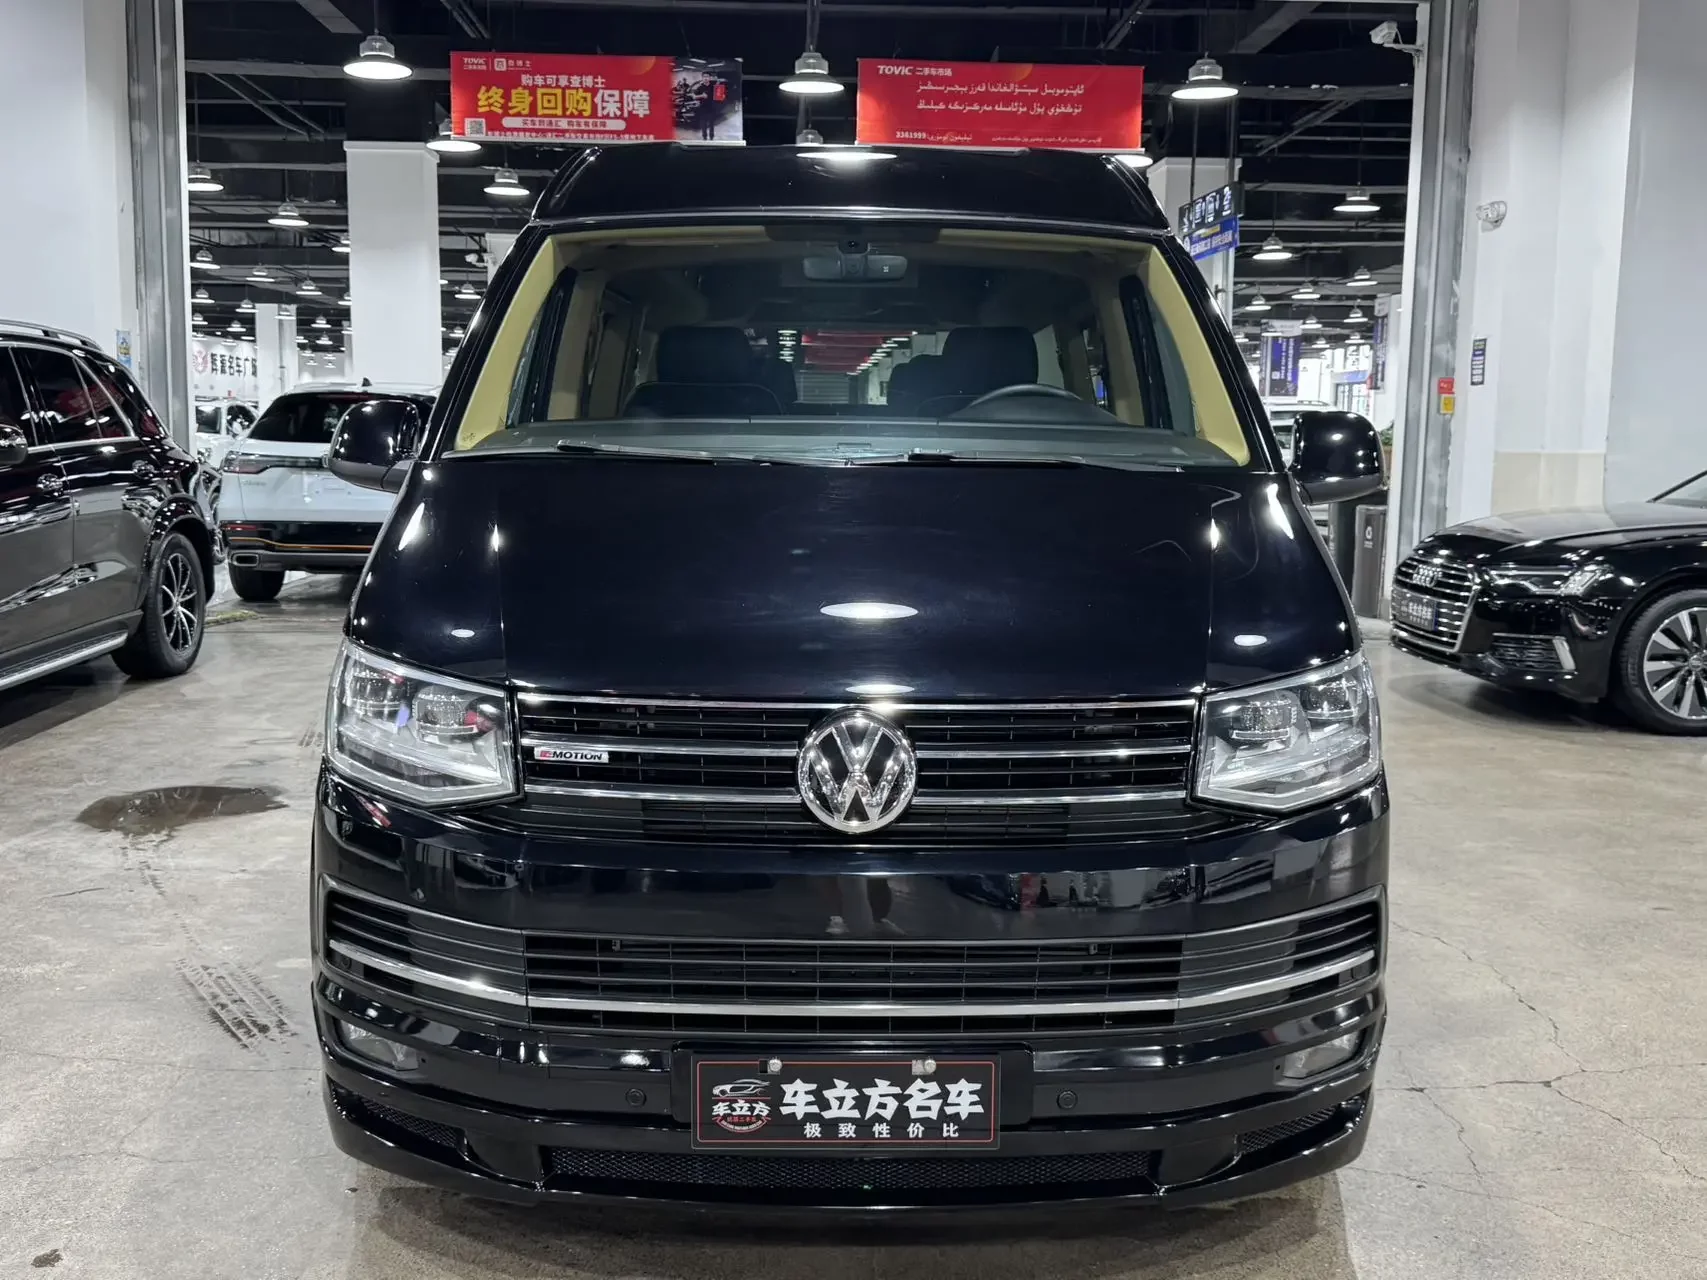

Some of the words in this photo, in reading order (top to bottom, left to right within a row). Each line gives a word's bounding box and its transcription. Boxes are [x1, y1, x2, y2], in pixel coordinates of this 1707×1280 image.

[877, 65, 914, 75] TOVIC
[521, 74, 606, 88] 购车可享查博士
[477, 85, 650, 118] 终身回购保障
[712, 1099, 771, 1117] 车立方
[779, 1078, 985, 1121] 车立方名车
[804, 1122, 960, 1138] 极致性价比
